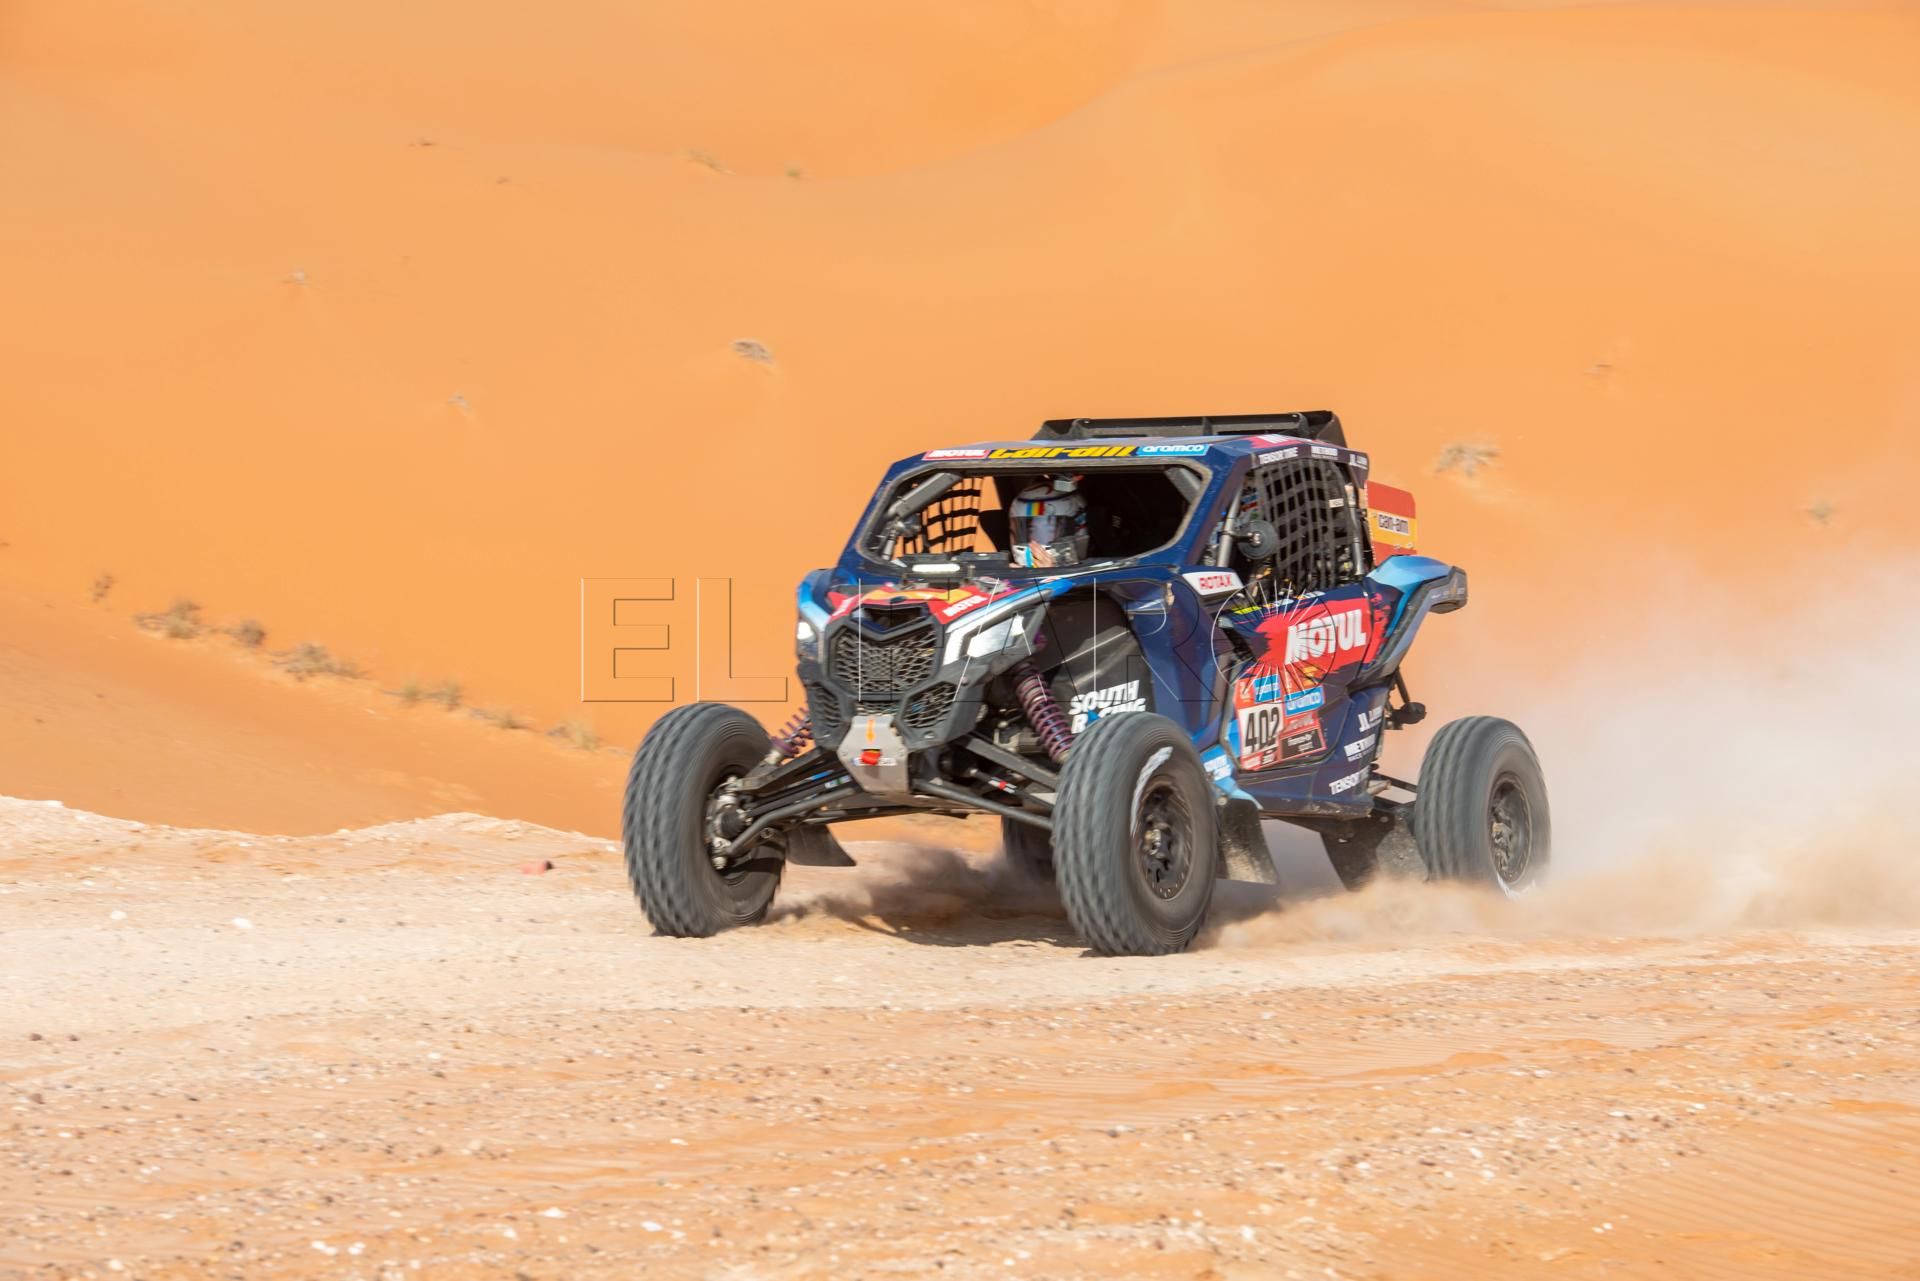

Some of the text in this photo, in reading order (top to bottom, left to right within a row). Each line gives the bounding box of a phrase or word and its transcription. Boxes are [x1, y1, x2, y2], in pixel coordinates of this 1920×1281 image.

[1142, 444, 1205, 454] aramco
[1376, 512, 1410, 536] can-am
[1199, 574, 1233, 590] ROTAX
[941, 594, 989, 617] MOTUL
[1283, 608, 1368, 666] MOTUL
[1068, 680, 1140, 715] SOUTH
[1286, 690, 1321, 712] aramco
[1245, 706, 1281, 755] 402
